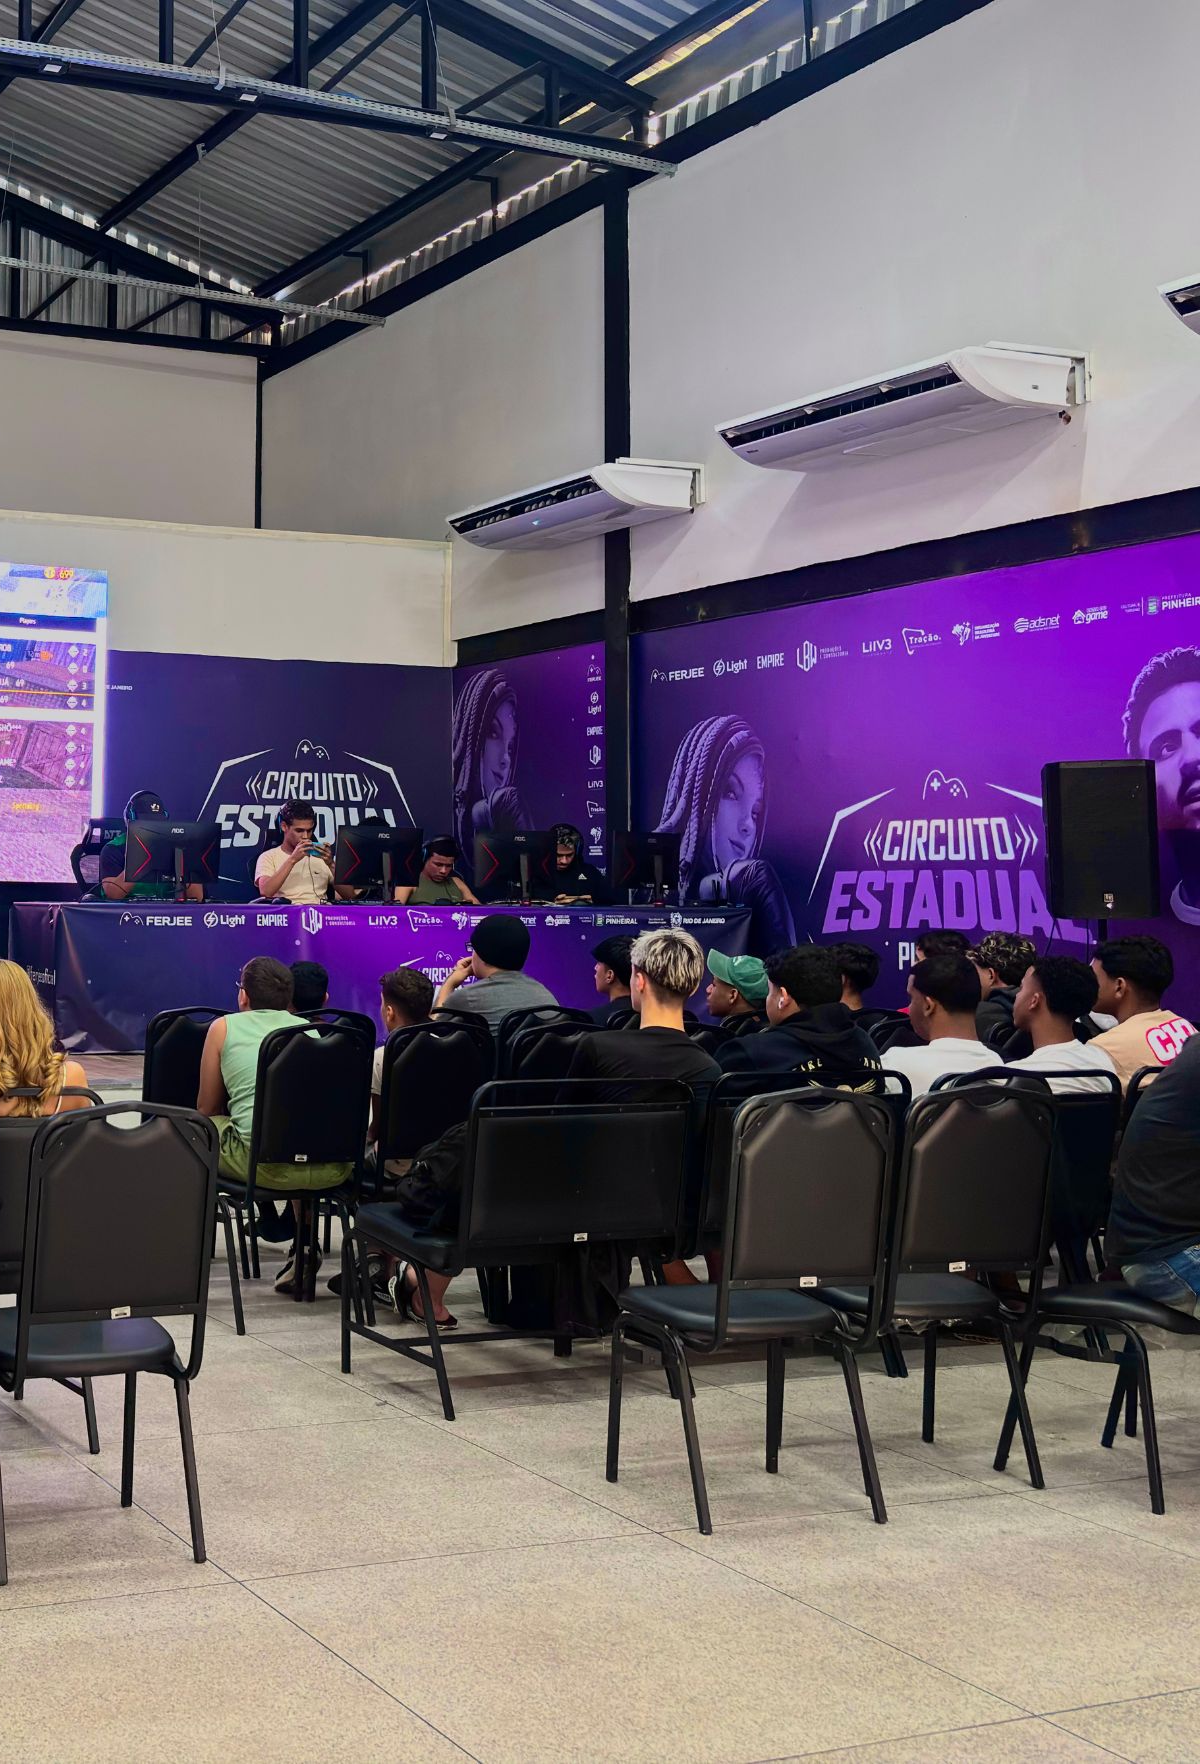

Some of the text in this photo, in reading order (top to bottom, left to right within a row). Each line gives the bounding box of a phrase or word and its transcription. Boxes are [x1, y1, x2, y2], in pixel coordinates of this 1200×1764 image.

[1161, 596, 1200, 611] PINHEIR
[1029, 613, 1060, 629] adsnet
[5, 661, 16, 670] 69
[726, 658, 748, 674] Light
[756, 652, 785, 669] EMPIRE
[668, 667, 705, 681] FERJEE
[15, 679, 26, 687] 69
[261, 771, 363, 802] CIRCUITO
[882, 817, 1015, 861] CIRCUITO
[146, 916, 193, 926] FERJEE
[220, 914, 246, 928] Light
[256, 914, 288, 927] EMPIRE
[301, 907, 323, 935] LBW
[413, 916, 443, 925] Tração.
[605, 917, 639, 925] PINHEIRAL
[1146, 1018, 1196, 1065] CH
